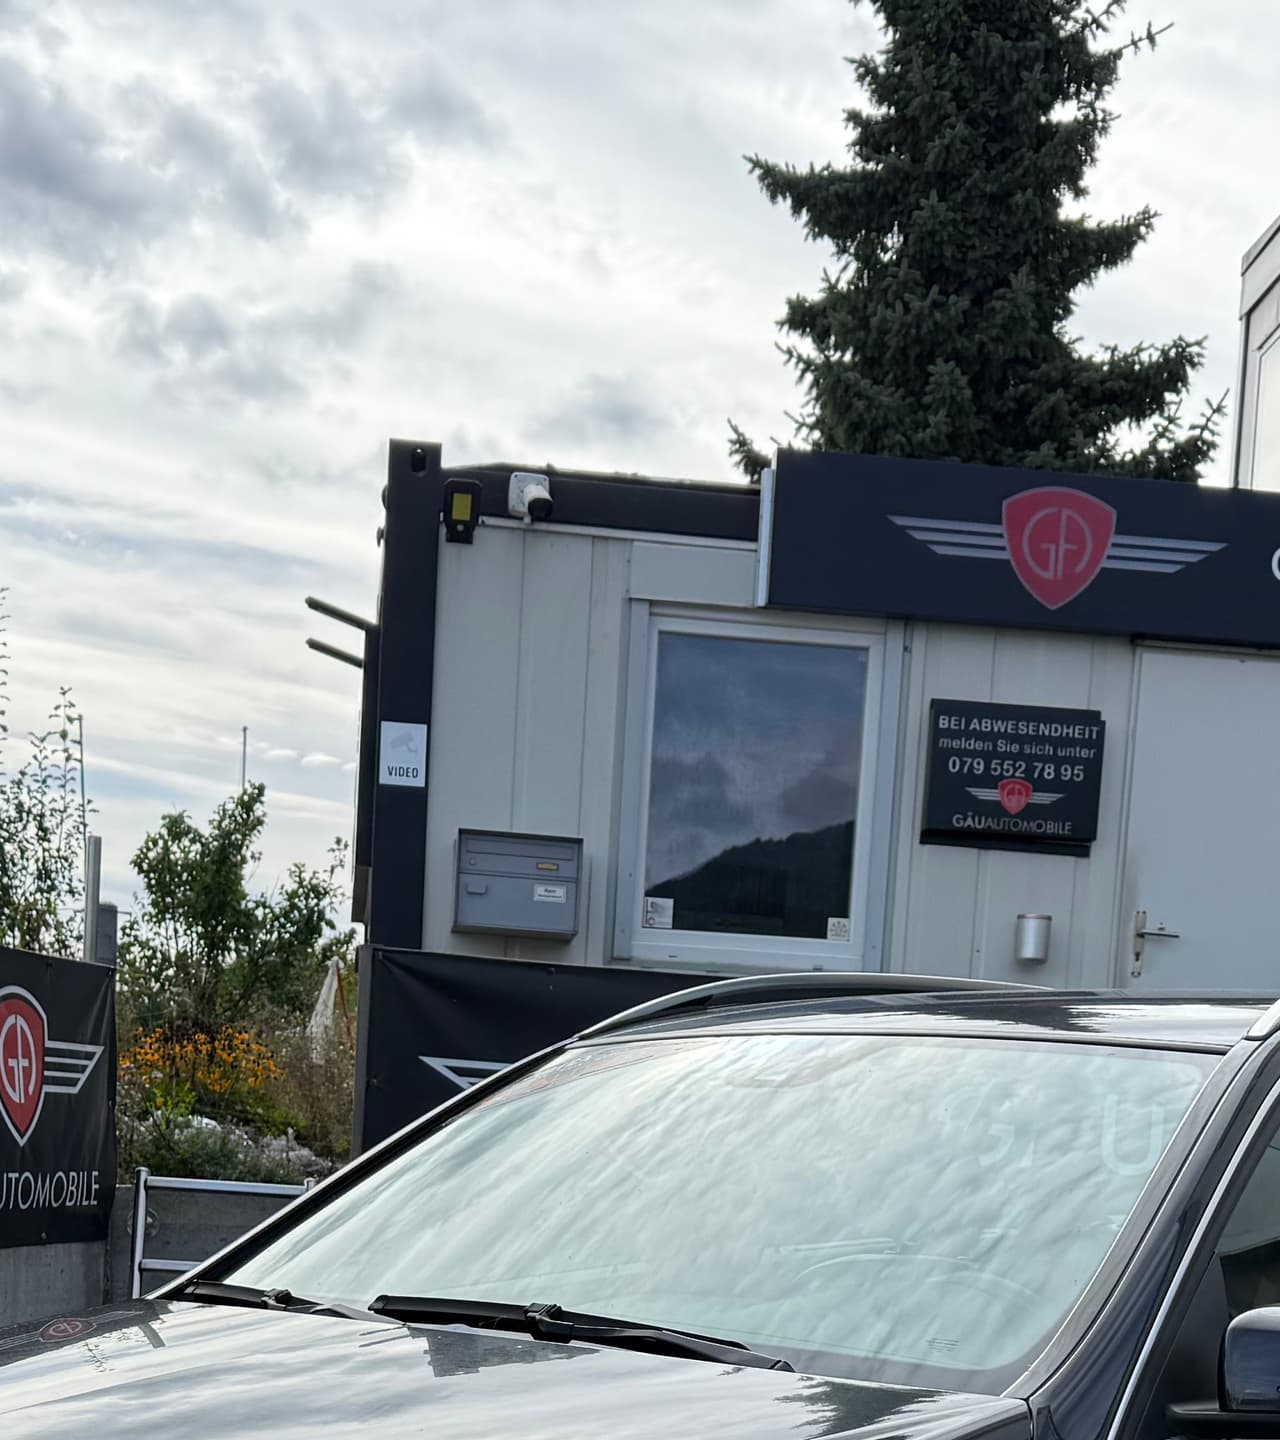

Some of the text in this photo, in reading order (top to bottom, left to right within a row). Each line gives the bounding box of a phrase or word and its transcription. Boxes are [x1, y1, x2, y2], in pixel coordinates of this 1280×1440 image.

[938, 714, 1101, 740] BEI ABWESENDHEIT
[938, 736, 1097, 759] melden Sie sich unter
[387, 765, 419, 779] VIDEO
[948, 756, 1085, 782] 079 552 78 95
[952, 812, 1073, 835] GÄUAUTOMOBILE
